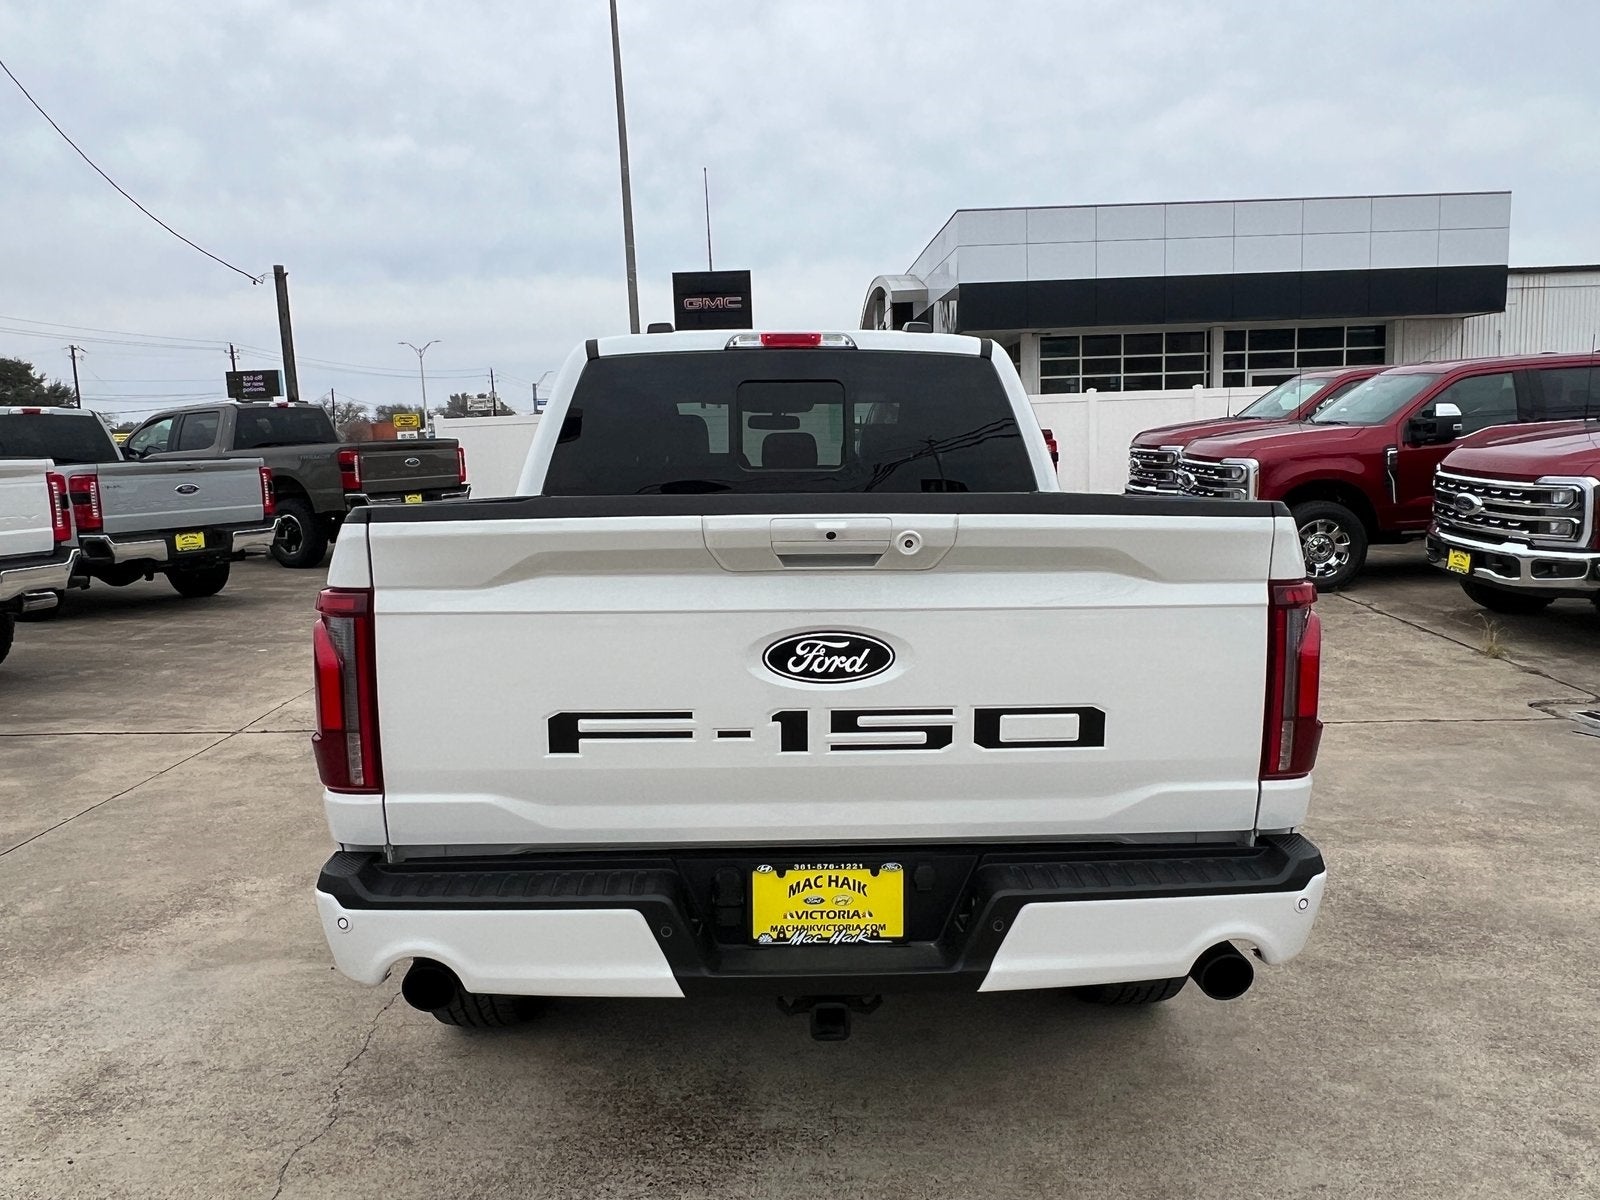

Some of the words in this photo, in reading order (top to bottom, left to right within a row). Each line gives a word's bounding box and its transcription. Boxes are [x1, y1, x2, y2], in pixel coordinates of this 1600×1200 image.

[683, 296, 742, 310] GMC
[787, 640, 871, 673] Ford
[547, 704, 1106, 755] F-150
[788, 875, 824, 899] MAC
[827, 875, 868, 897] HAIK
[795, 910, 862, 920] VICTORIA
[770, 924, 886, 932] MACHAIKVICTORIACOM
[789, 929, 829, 945] Mac
[828, 929, 871, 945] Haik
